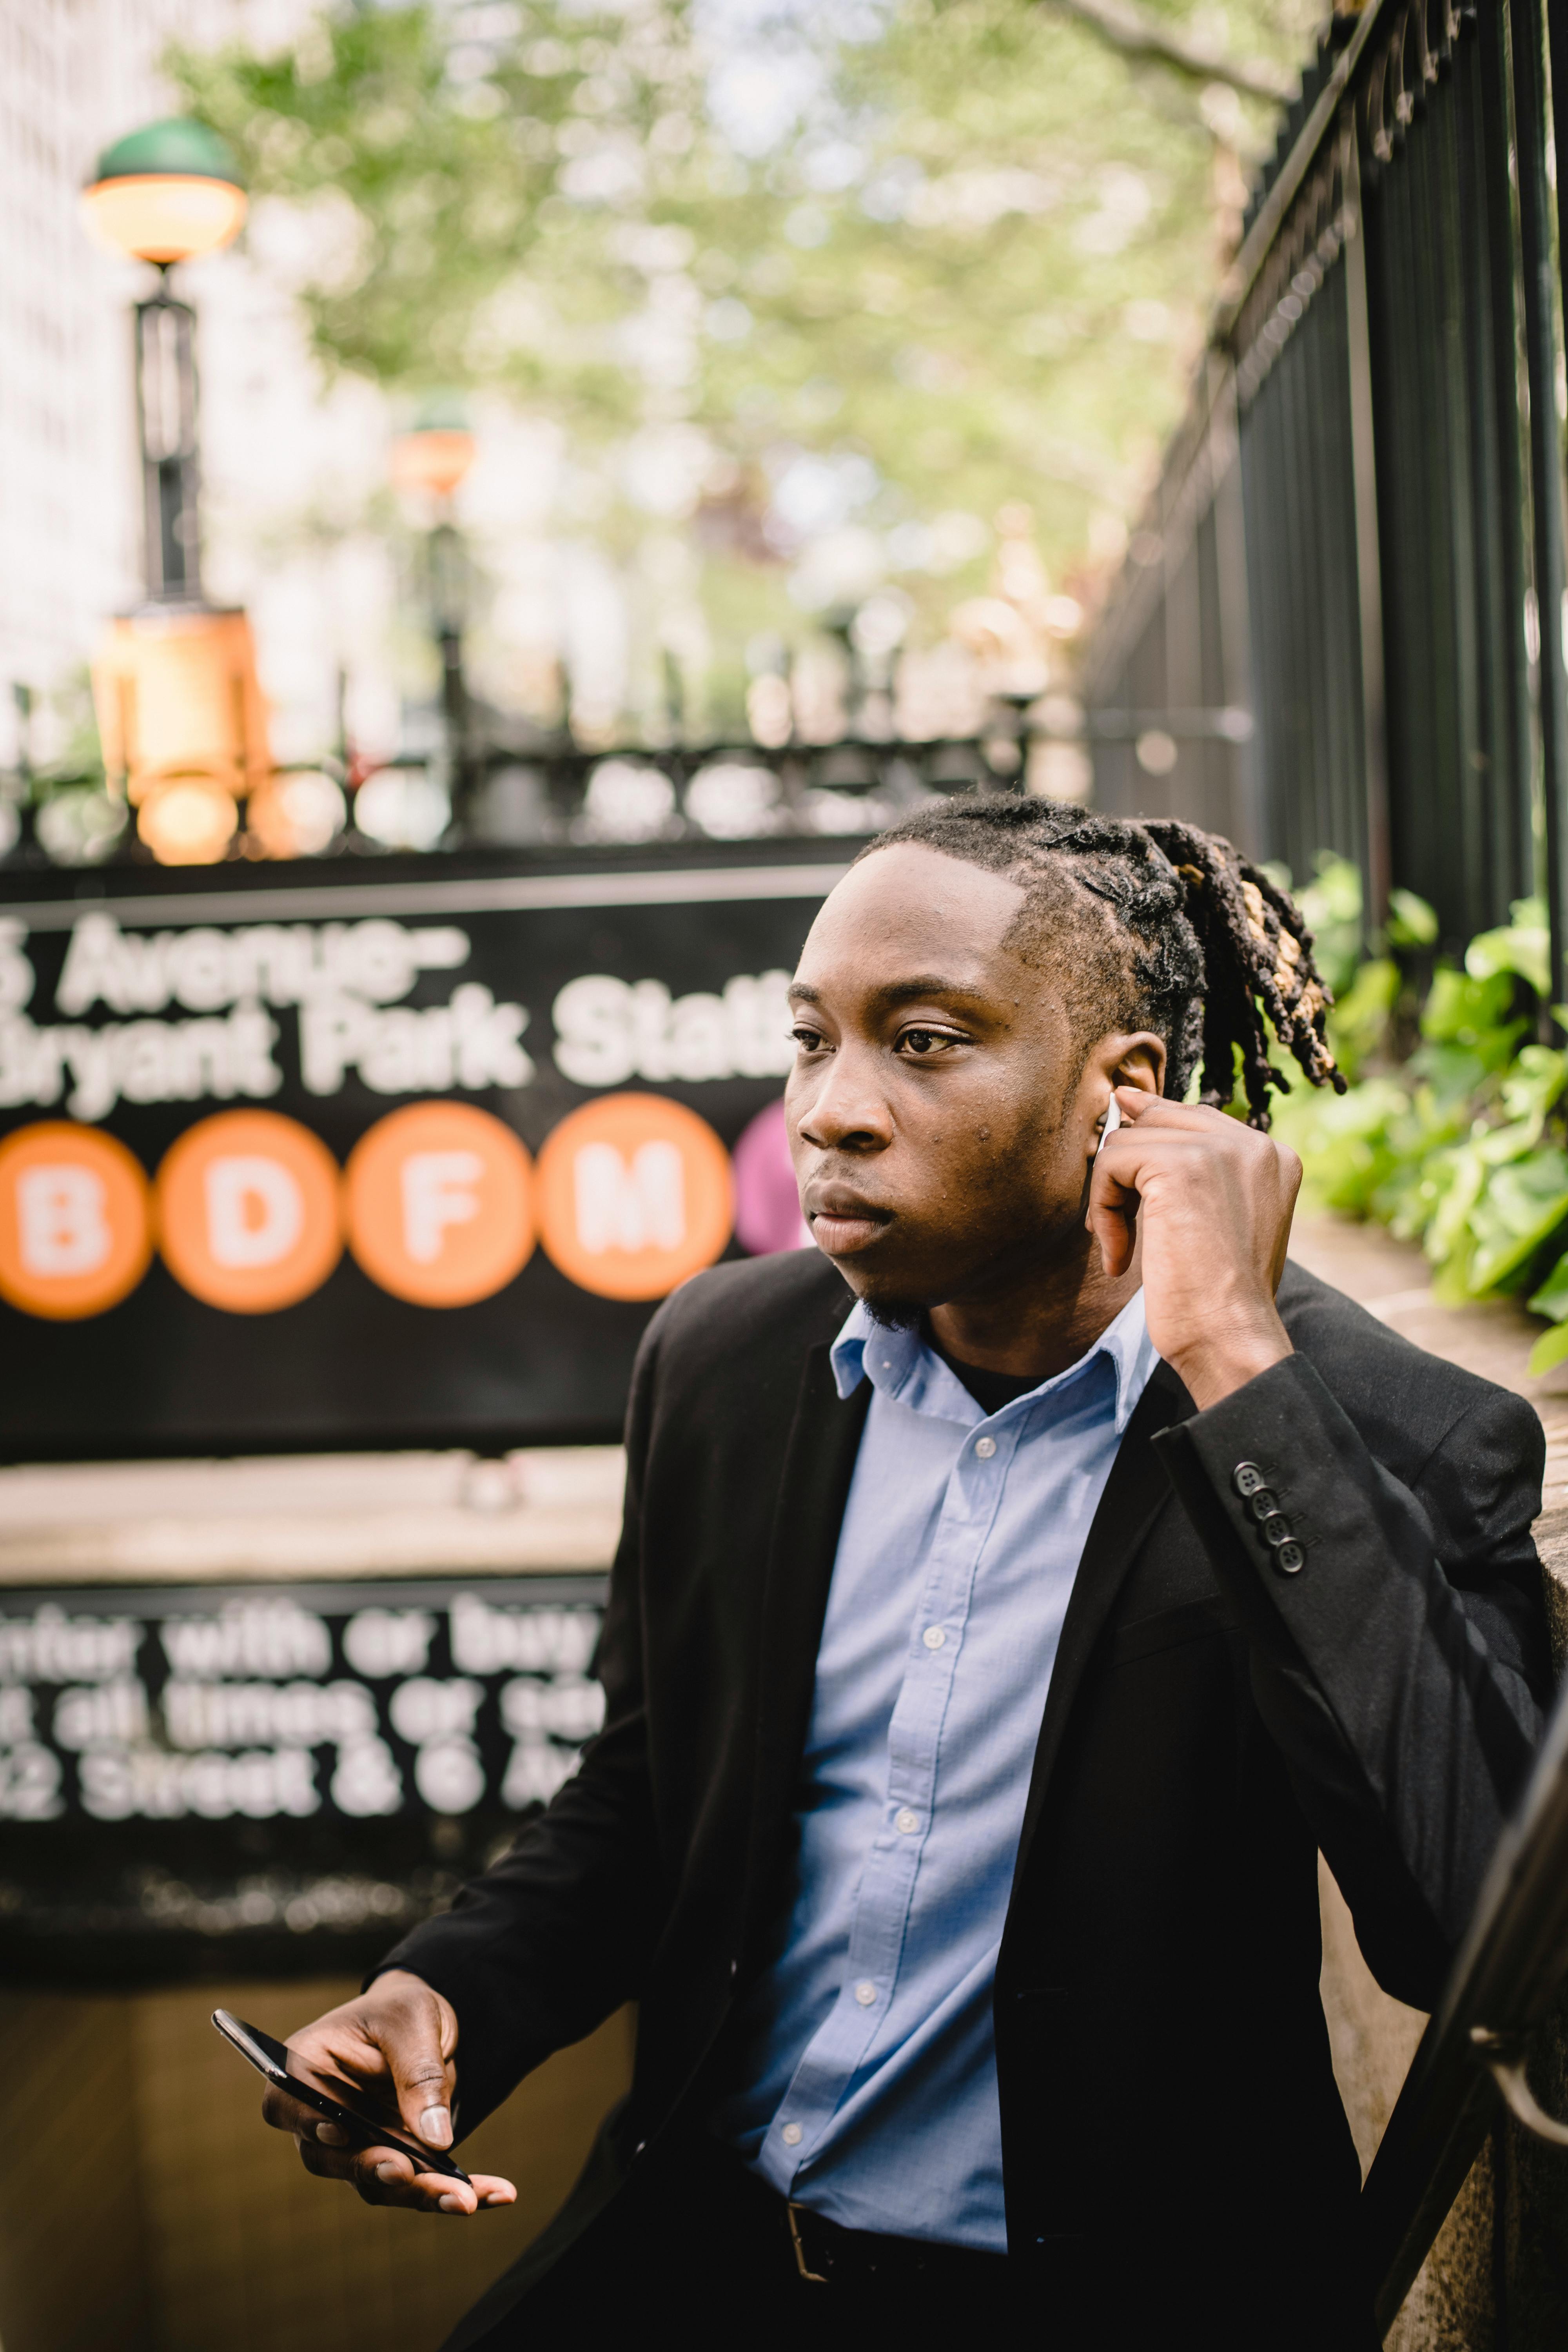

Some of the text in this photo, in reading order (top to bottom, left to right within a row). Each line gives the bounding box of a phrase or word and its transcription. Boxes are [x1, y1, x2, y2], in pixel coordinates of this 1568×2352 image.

[55, 911, 470, 1015] Avenue-
[296, 982, 535, 1096] Park
[15, 1164, 113, 1279] B
[202, 1155, 305, 1269] D
[401, 1151, 485, 1264] F
[572, 1139, 687, 1255] M
[77, 1738, 322, 1820] Street
